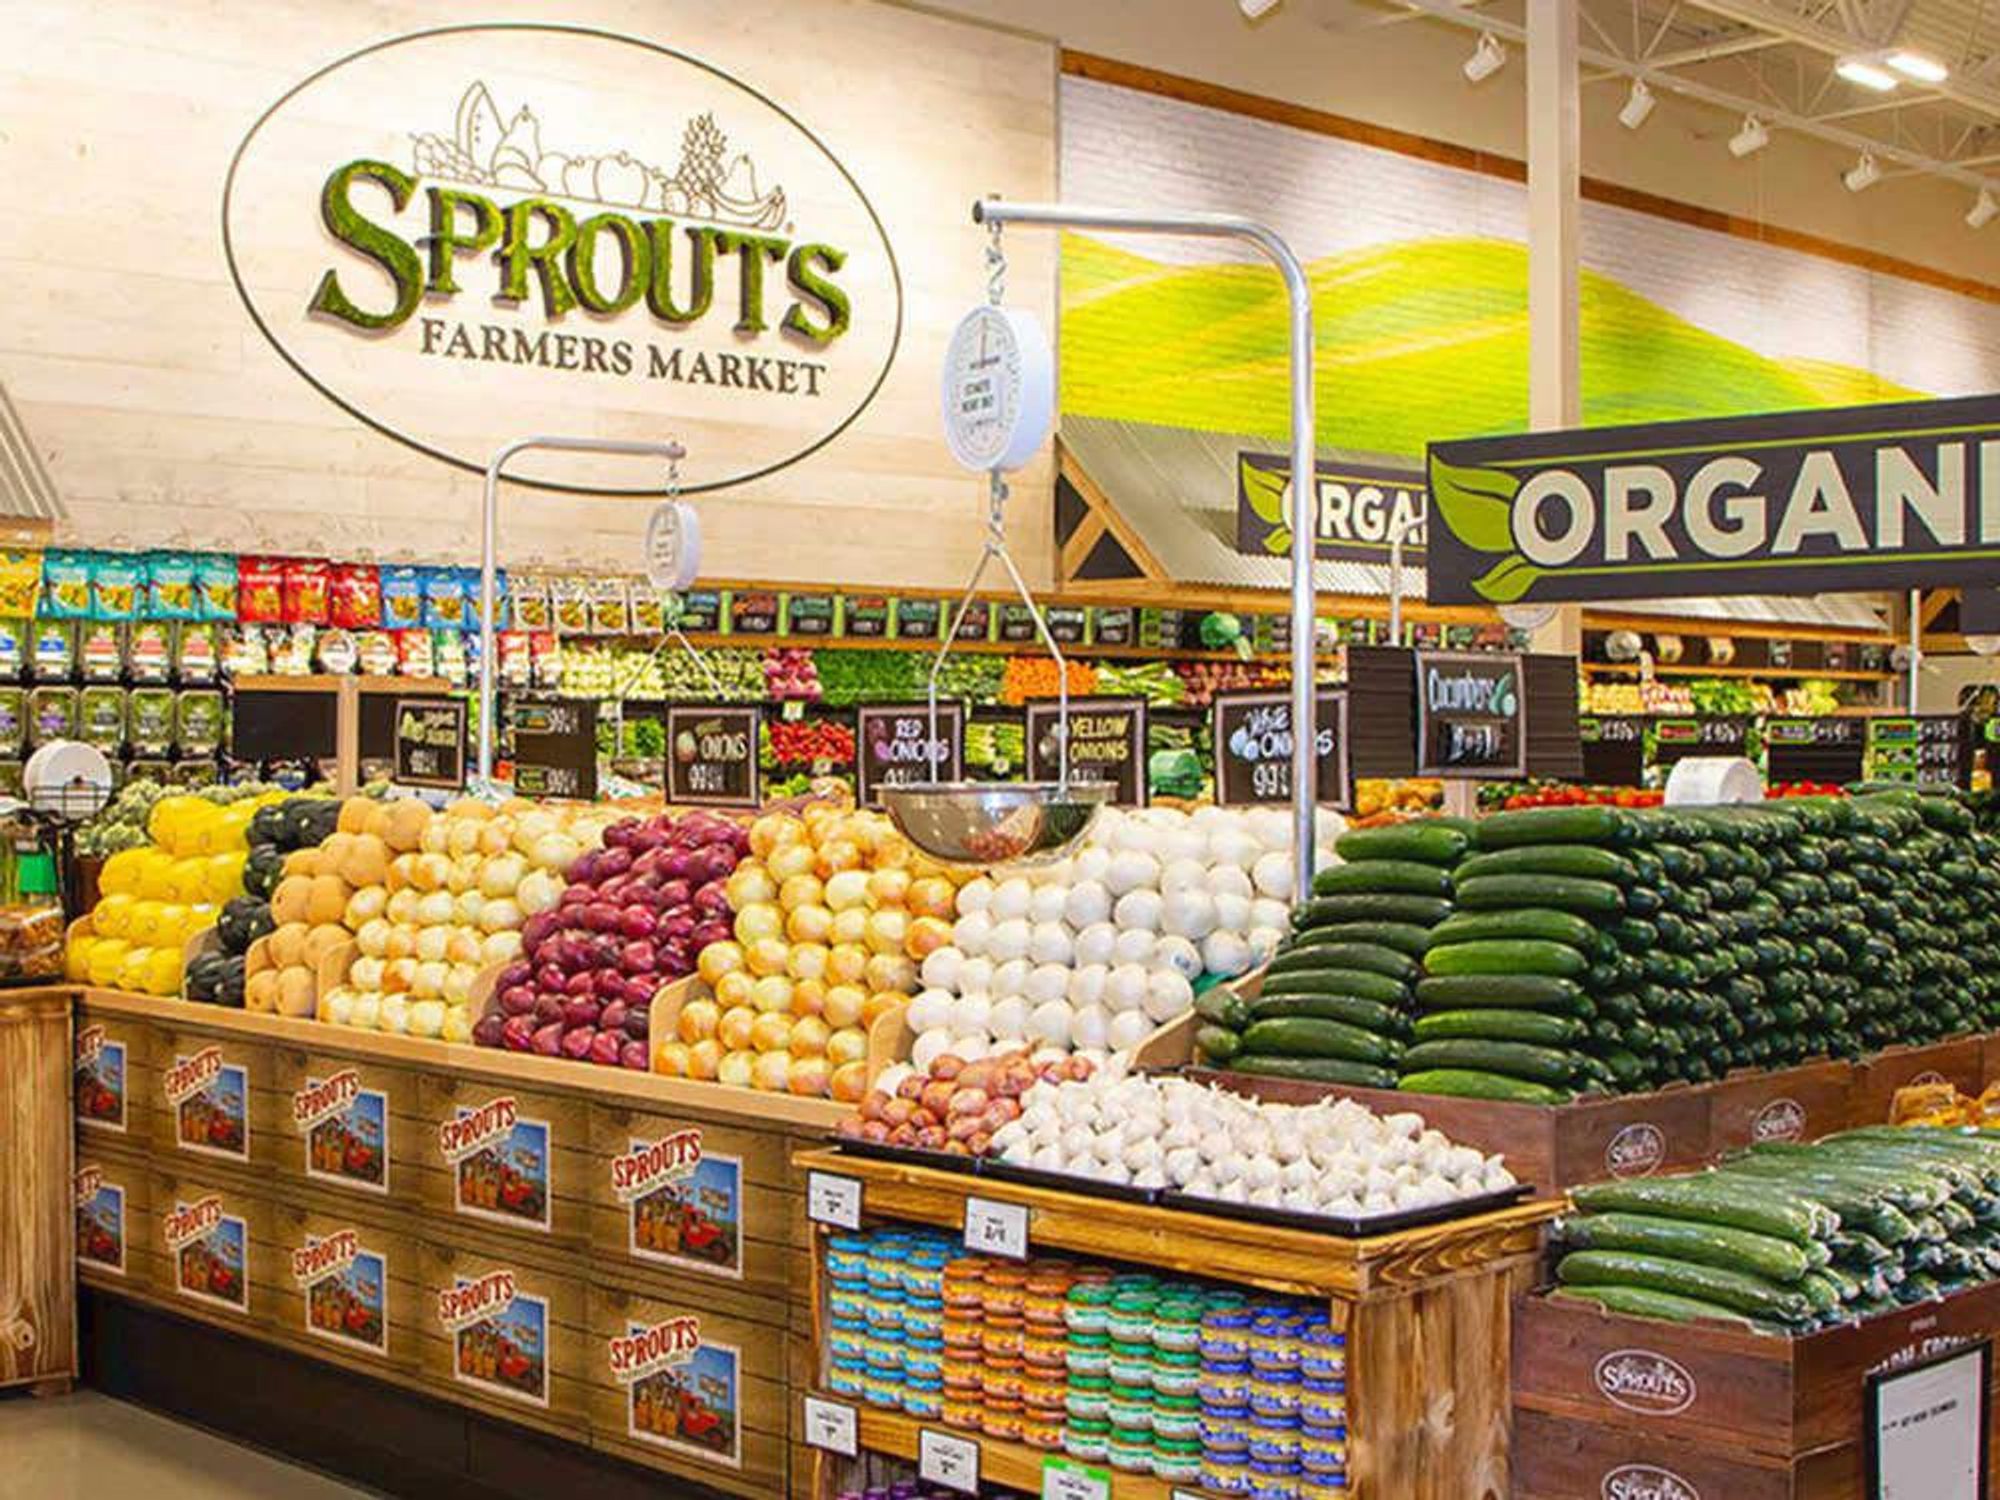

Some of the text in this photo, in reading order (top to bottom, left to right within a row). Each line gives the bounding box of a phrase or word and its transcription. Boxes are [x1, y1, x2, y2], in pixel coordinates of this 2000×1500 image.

[308, 159, 852, 350] SPROUTS
[420, 316, 827, 396] FARMERS MARKET
[1510, 440, 2000, 568] ORGANI
[1070, 717, 1129, 737] YELLOW
[1070, 740, 1129, 762] ONIONS
[441, 1100, 515, 1151] SPROUTS
[613, 1132, 701, 1188] SPROUTS
[440, 1273, 513, 1319] SPROUTS
[610, 1319, 698, 1369] SPROUTS
